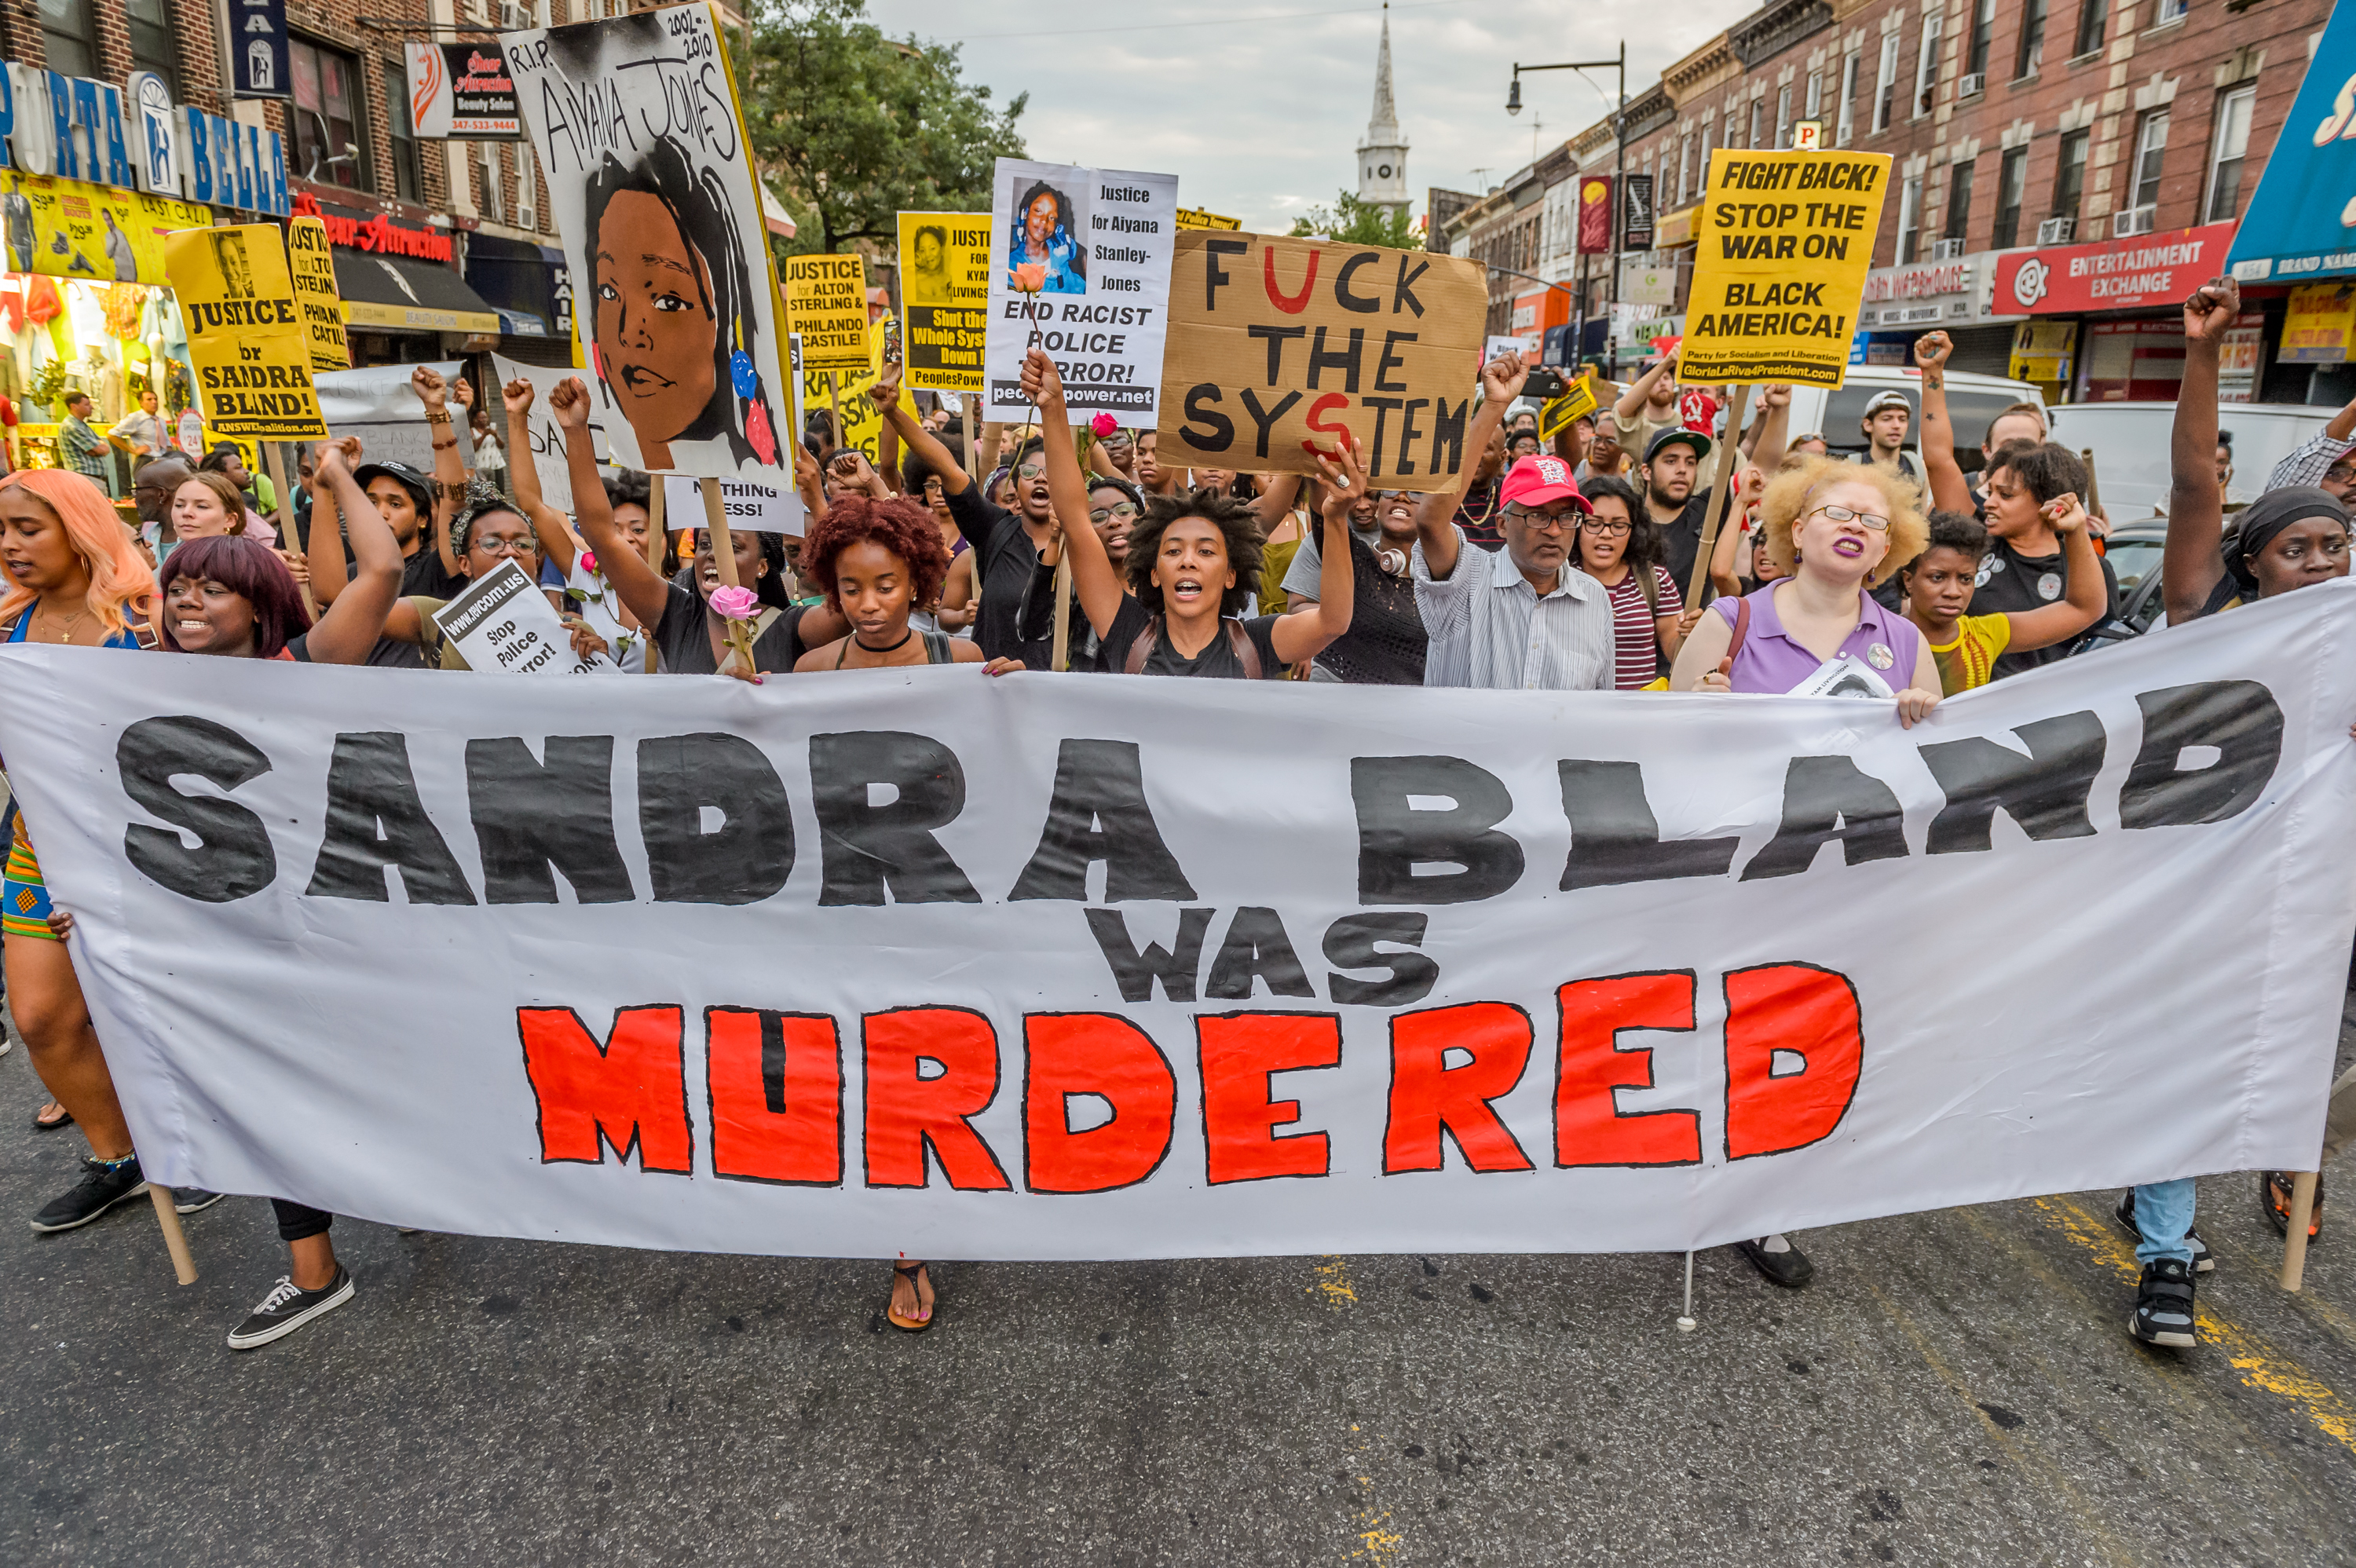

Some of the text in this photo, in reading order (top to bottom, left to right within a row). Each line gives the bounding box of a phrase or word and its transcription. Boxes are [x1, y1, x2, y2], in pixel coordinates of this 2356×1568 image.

[509, 39, 554, 74] R.I.P.
[683, 33, 712, 60] 2010
[466, 50, 500, 73] Shear
[454, 74, 513, 93] Attraction
[457, 97, 514, 112] Beauty Salon
[616, 56, 736, 162] JONES
[452, 120, 516, 130] 347-533-9444
[185, 106, 291, 217] BELLA
[1721, 161, 1880, 192] FIGHT BACK!
[61, 194, 90, 207] SHOES
[1100, 184, 1151, 203] Justice
[63, 207, 93, 219] BOOTS
[140, 197, 170, 218] LAST
[174, 204, 207, 225] CALL
[1184, 211, 1209, 226] Police
[1714, 203, 1868, 231] STOP THE
[952, 229, 990, 247] JUSTI
[1092, 214, 1159, 239] for Aiyana
[970, 253, 988, 265] FOR
[1095, 244, 1151, 265] Stanley-
[1721, 234, 1849, 261] WAR ON
[2069, 240, 2204, 277] ENTERTAINMENT
[789, 260, 862, 280] JUSTICE
[1206, 239, 1431, 319] FUCK
[797, 283, 854, 297] for ALTON
[953, 286, 989, 298] LIVINGS
[1101, 275, 1141, 292] Jones
[1724, 282, 1827, 307] BLACK
[2091, 271, 2172, 298] EXCHANGE
[554, 269, 573, 331] HAIR
[791, 298, 863, 311] STERLING &
[188, 298, 296, 334] JUSTICE
[405, 310, 432, 325] BEAUTY
[433, 314, 458, 327] SALON
[933, 309, 987, 328] Shut the
[1004, 300, 1153, 326] END RACIST
[795, 318, 863, 333] PHILANDO
[913, 327, 986, 348] Whole Syst
[1694, 313, 1846, 339] AMERICA!
[802, 333, 861, 348] CASTILE!
[1026, 330, 1127, 354] POLICE
[941, 347, 977, 366] Down
[1247, 324, 1418, 393] THE
[1688, 349, 1841, 362] Party for Socialism and Liberation
[202, 365, 311, 389] SANDRA
[915, 371, 985, 386] PeoplesPowe
[1683, 364, 1837, 381] GloriaLaRiva4President.com
[1178, 382, 1469, 477] SYSTEM
[693, 481, 777, 499] NTHING
[724, 503, 763, 517] ESS!
[444, 572, 525, 637] www.revcom.us
[486, 620, 517, 646] Stop
[496, 630, 539, 668] Police
[1821, 663, 1849, 688] LIVINGSTON
[115, 679, 2285, 906] SANDRA BLAND
[1083, 905, 1440, 1007] WAS
[514, 961, 1865, 1195] MURDERED
